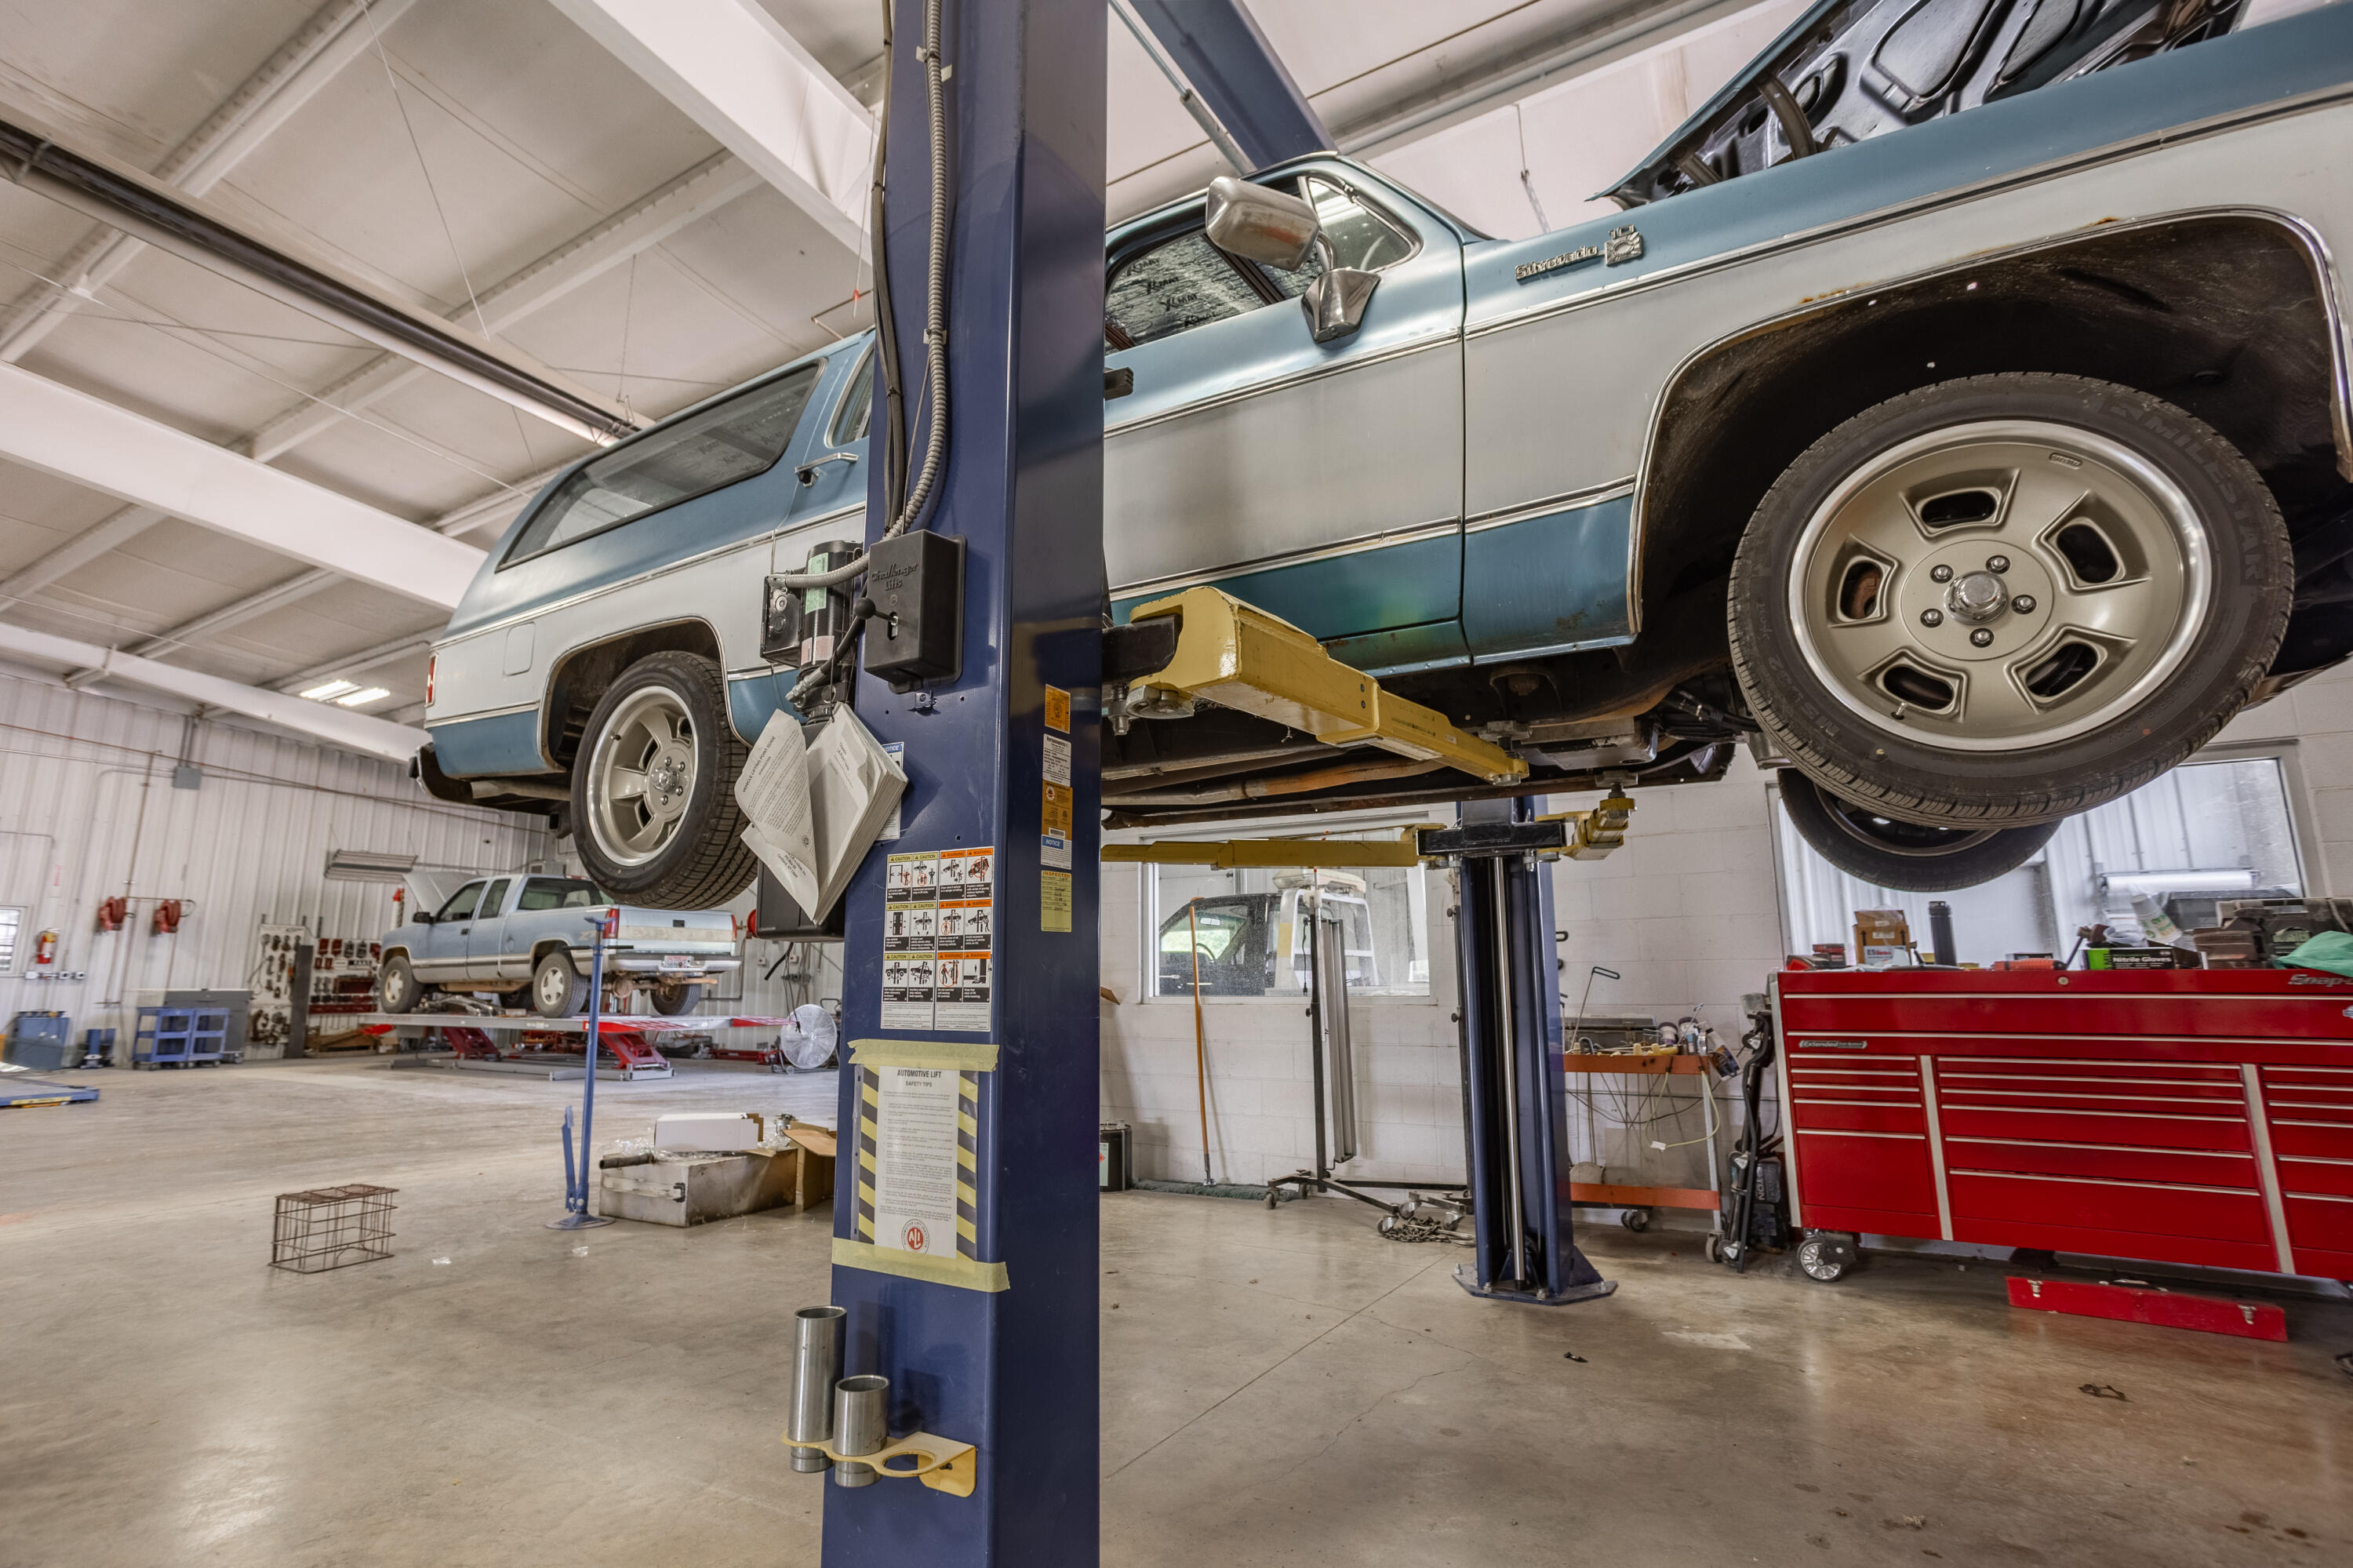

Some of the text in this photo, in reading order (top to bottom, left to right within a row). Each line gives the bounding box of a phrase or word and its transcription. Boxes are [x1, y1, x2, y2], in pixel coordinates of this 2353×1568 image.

[1515, 245, 1598, 280] Silverado
[2144, 413, 2263, 580] MILESTAR
[871, 563, 918, 582] Challenger
[884, 579, 904, 591] Lifts
[743, 773, 753, 792] VEHICLE
[752, 760, 761, 775] LIFTING
[767, 735, 776, 748] GUIDE
[1046, 839, 1060, 847] NOTICE
[897, 1069, 929, 1078] AUTOMOTIVE
